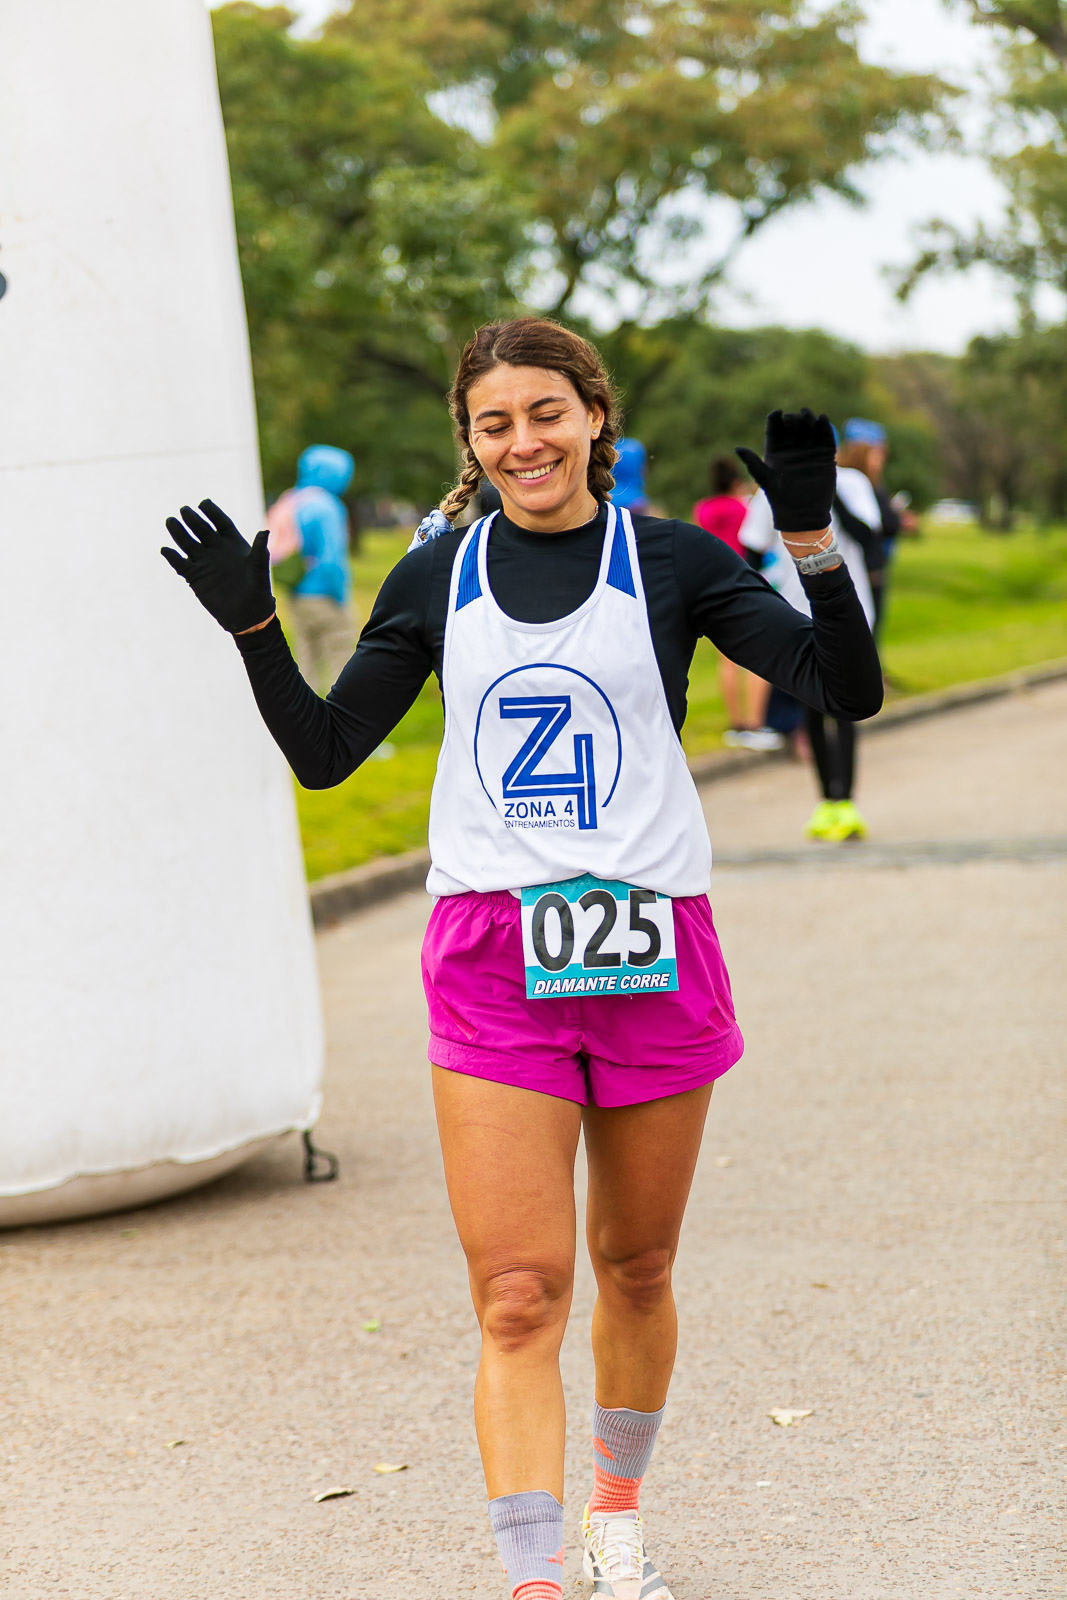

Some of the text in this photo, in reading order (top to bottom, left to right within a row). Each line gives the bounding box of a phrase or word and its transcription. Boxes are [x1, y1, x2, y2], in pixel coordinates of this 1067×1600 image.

[504, 800, 574, 818] ZONA 4
[504, 819, 576, 829] ENTRENAMIENTOS
[532, 889, 661, 972] 025
[533, 973, 671, 995] DIAMANTE CORRE
